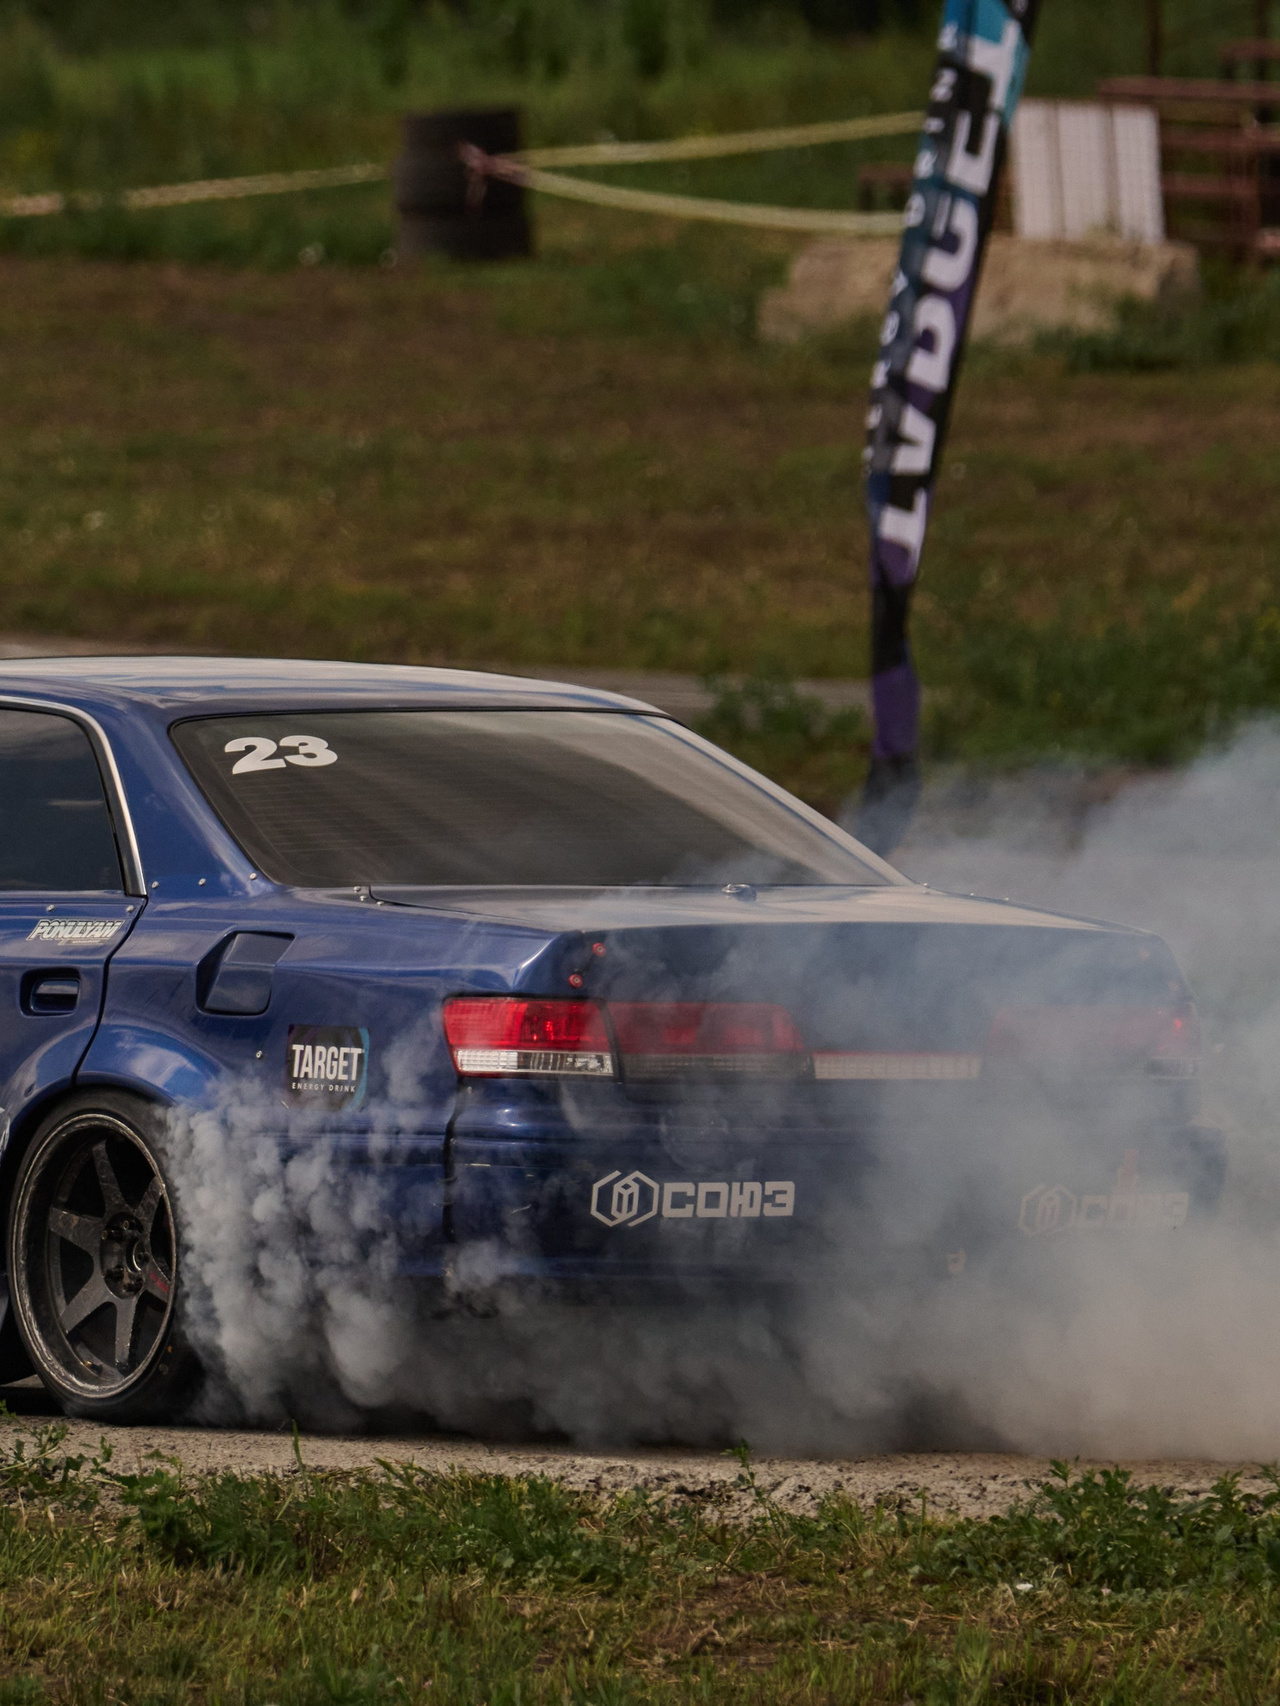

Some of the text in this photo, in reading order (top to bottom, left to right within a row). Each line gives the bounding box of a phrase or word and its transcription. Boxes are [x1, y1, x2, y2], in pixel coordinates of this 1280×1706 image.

[224, 735, 338, 774] 23
[292, 1045, 362, 1080] TARGET
[291, 1082, 356, 1092] ENERGY DRINK
[661, 1181, 795, 1218] СОЮЗ
